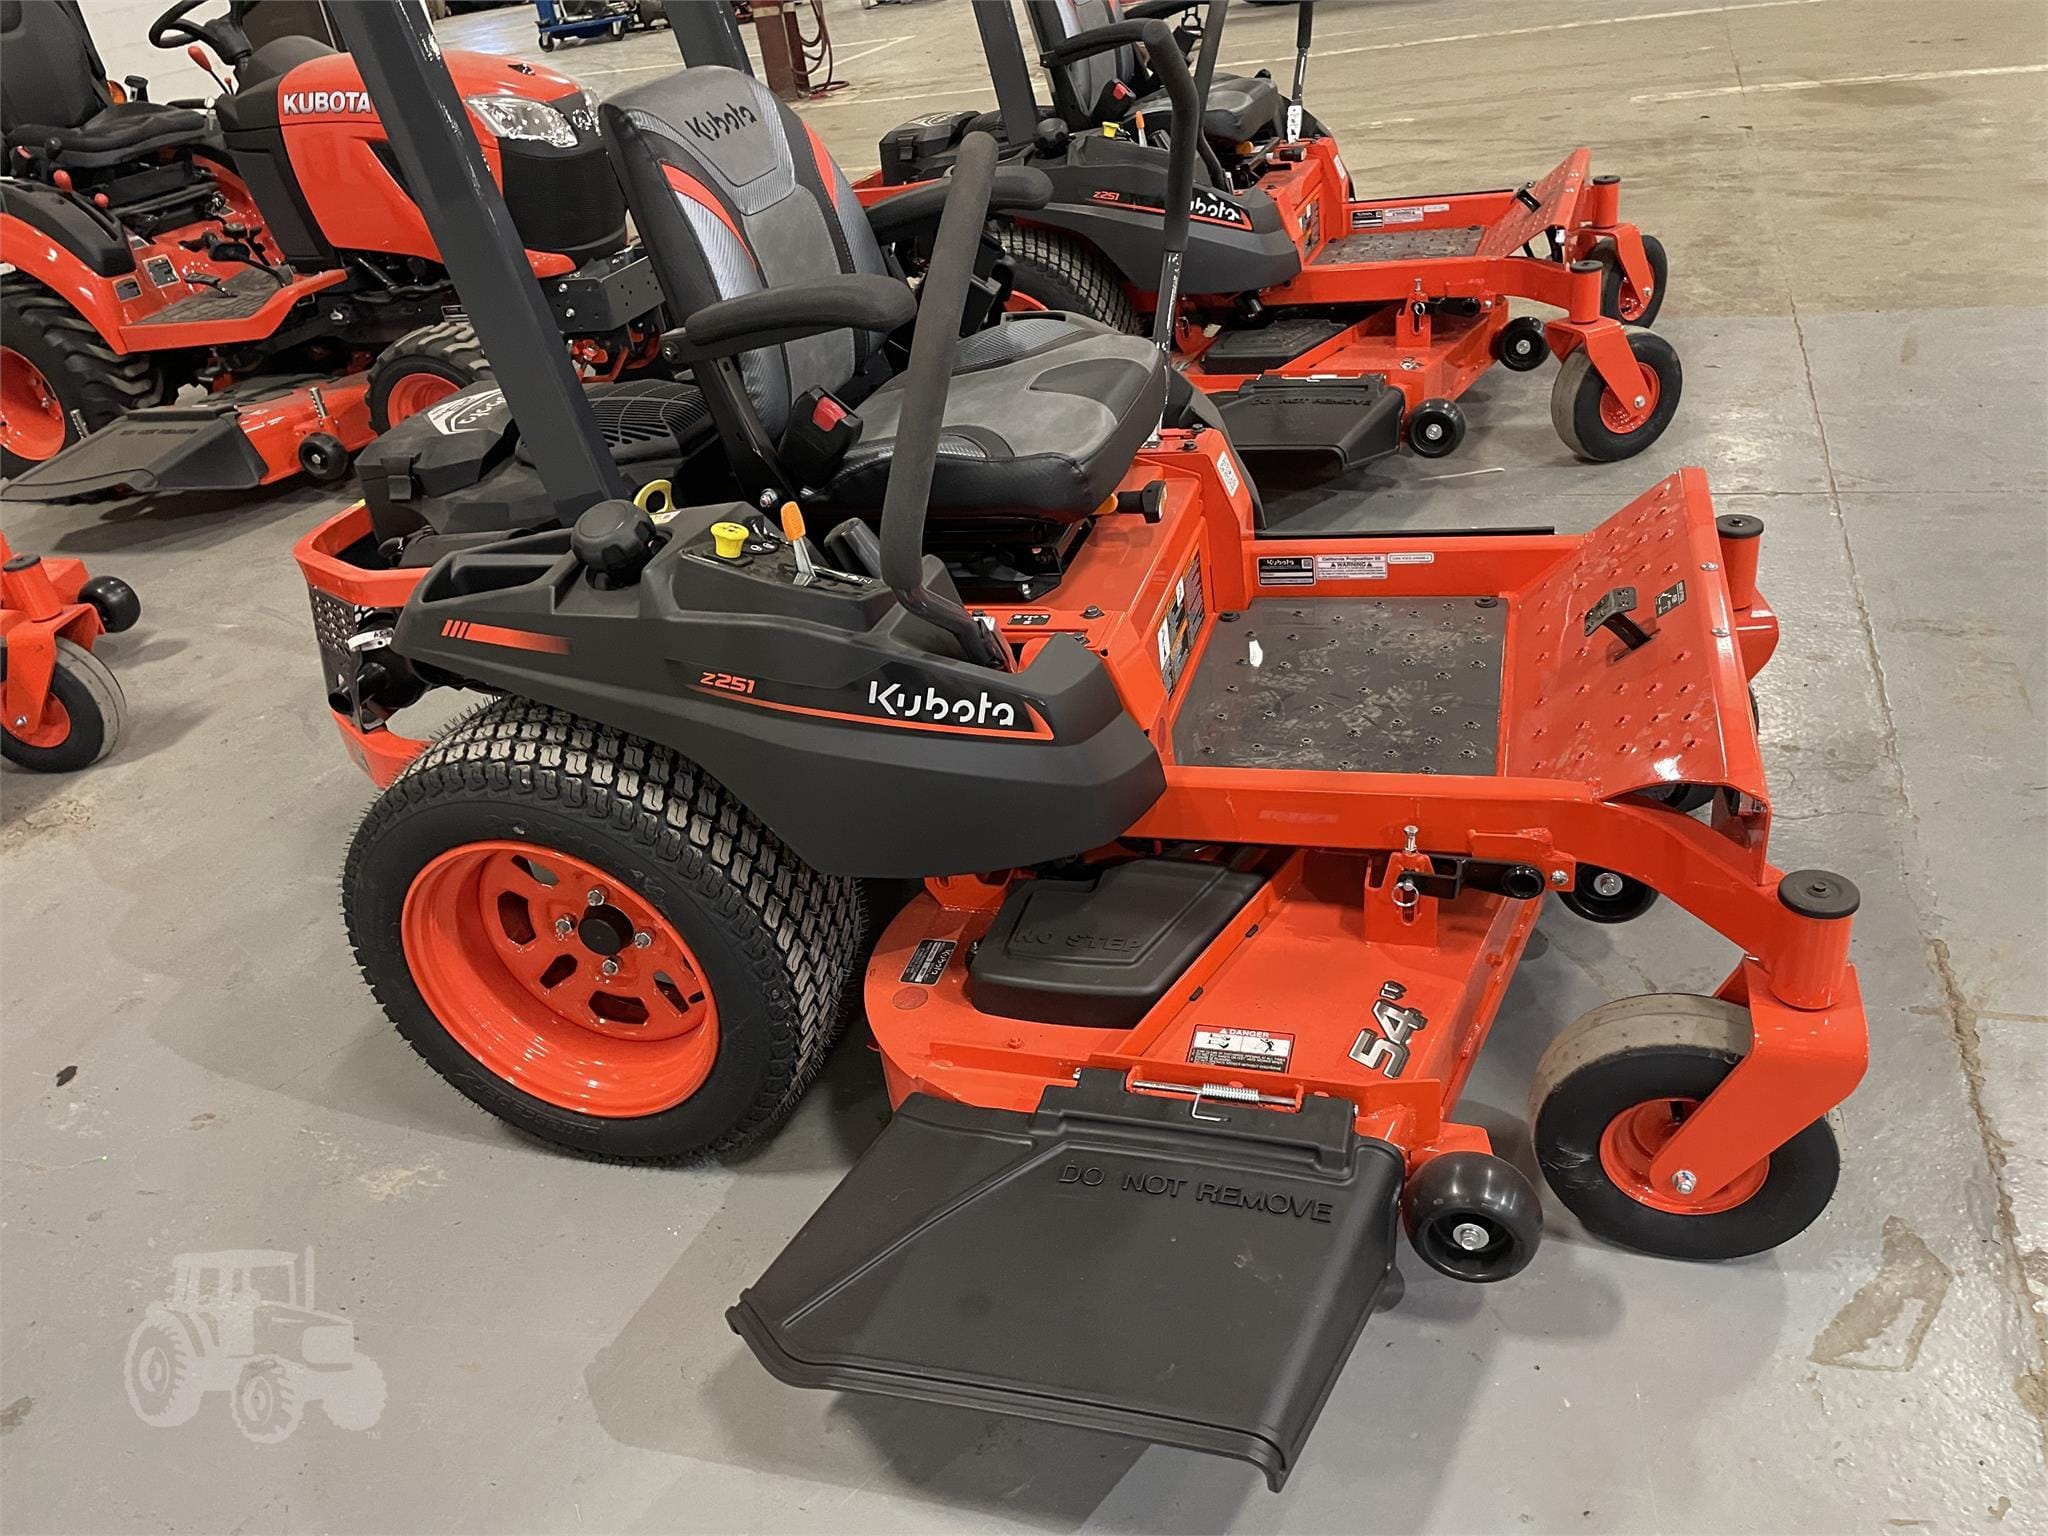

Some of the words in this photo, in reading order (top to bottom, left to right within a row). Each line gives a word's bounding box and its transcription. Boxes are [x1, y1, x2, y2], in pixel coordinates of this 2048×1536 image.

[283, 91, 372, 115] KUBOTA
[684, 102, 757, 141] Kubota
[1092, 190, 1120, 201] Z251
[700, 672, 756, 694] Z251
[868, 680, 1016, 727] Kubota
[1013, 929, 1053, 945] NO
[1065, 934, 1147, 953] STEP
[1229, 1028, 1271, 1039] DANGER
[1058, 1164, 1105, 1187] DO
[1120, 1172, 1188, 1198] NOT
[1195, 1181, 1334, 1224] REMOVE
